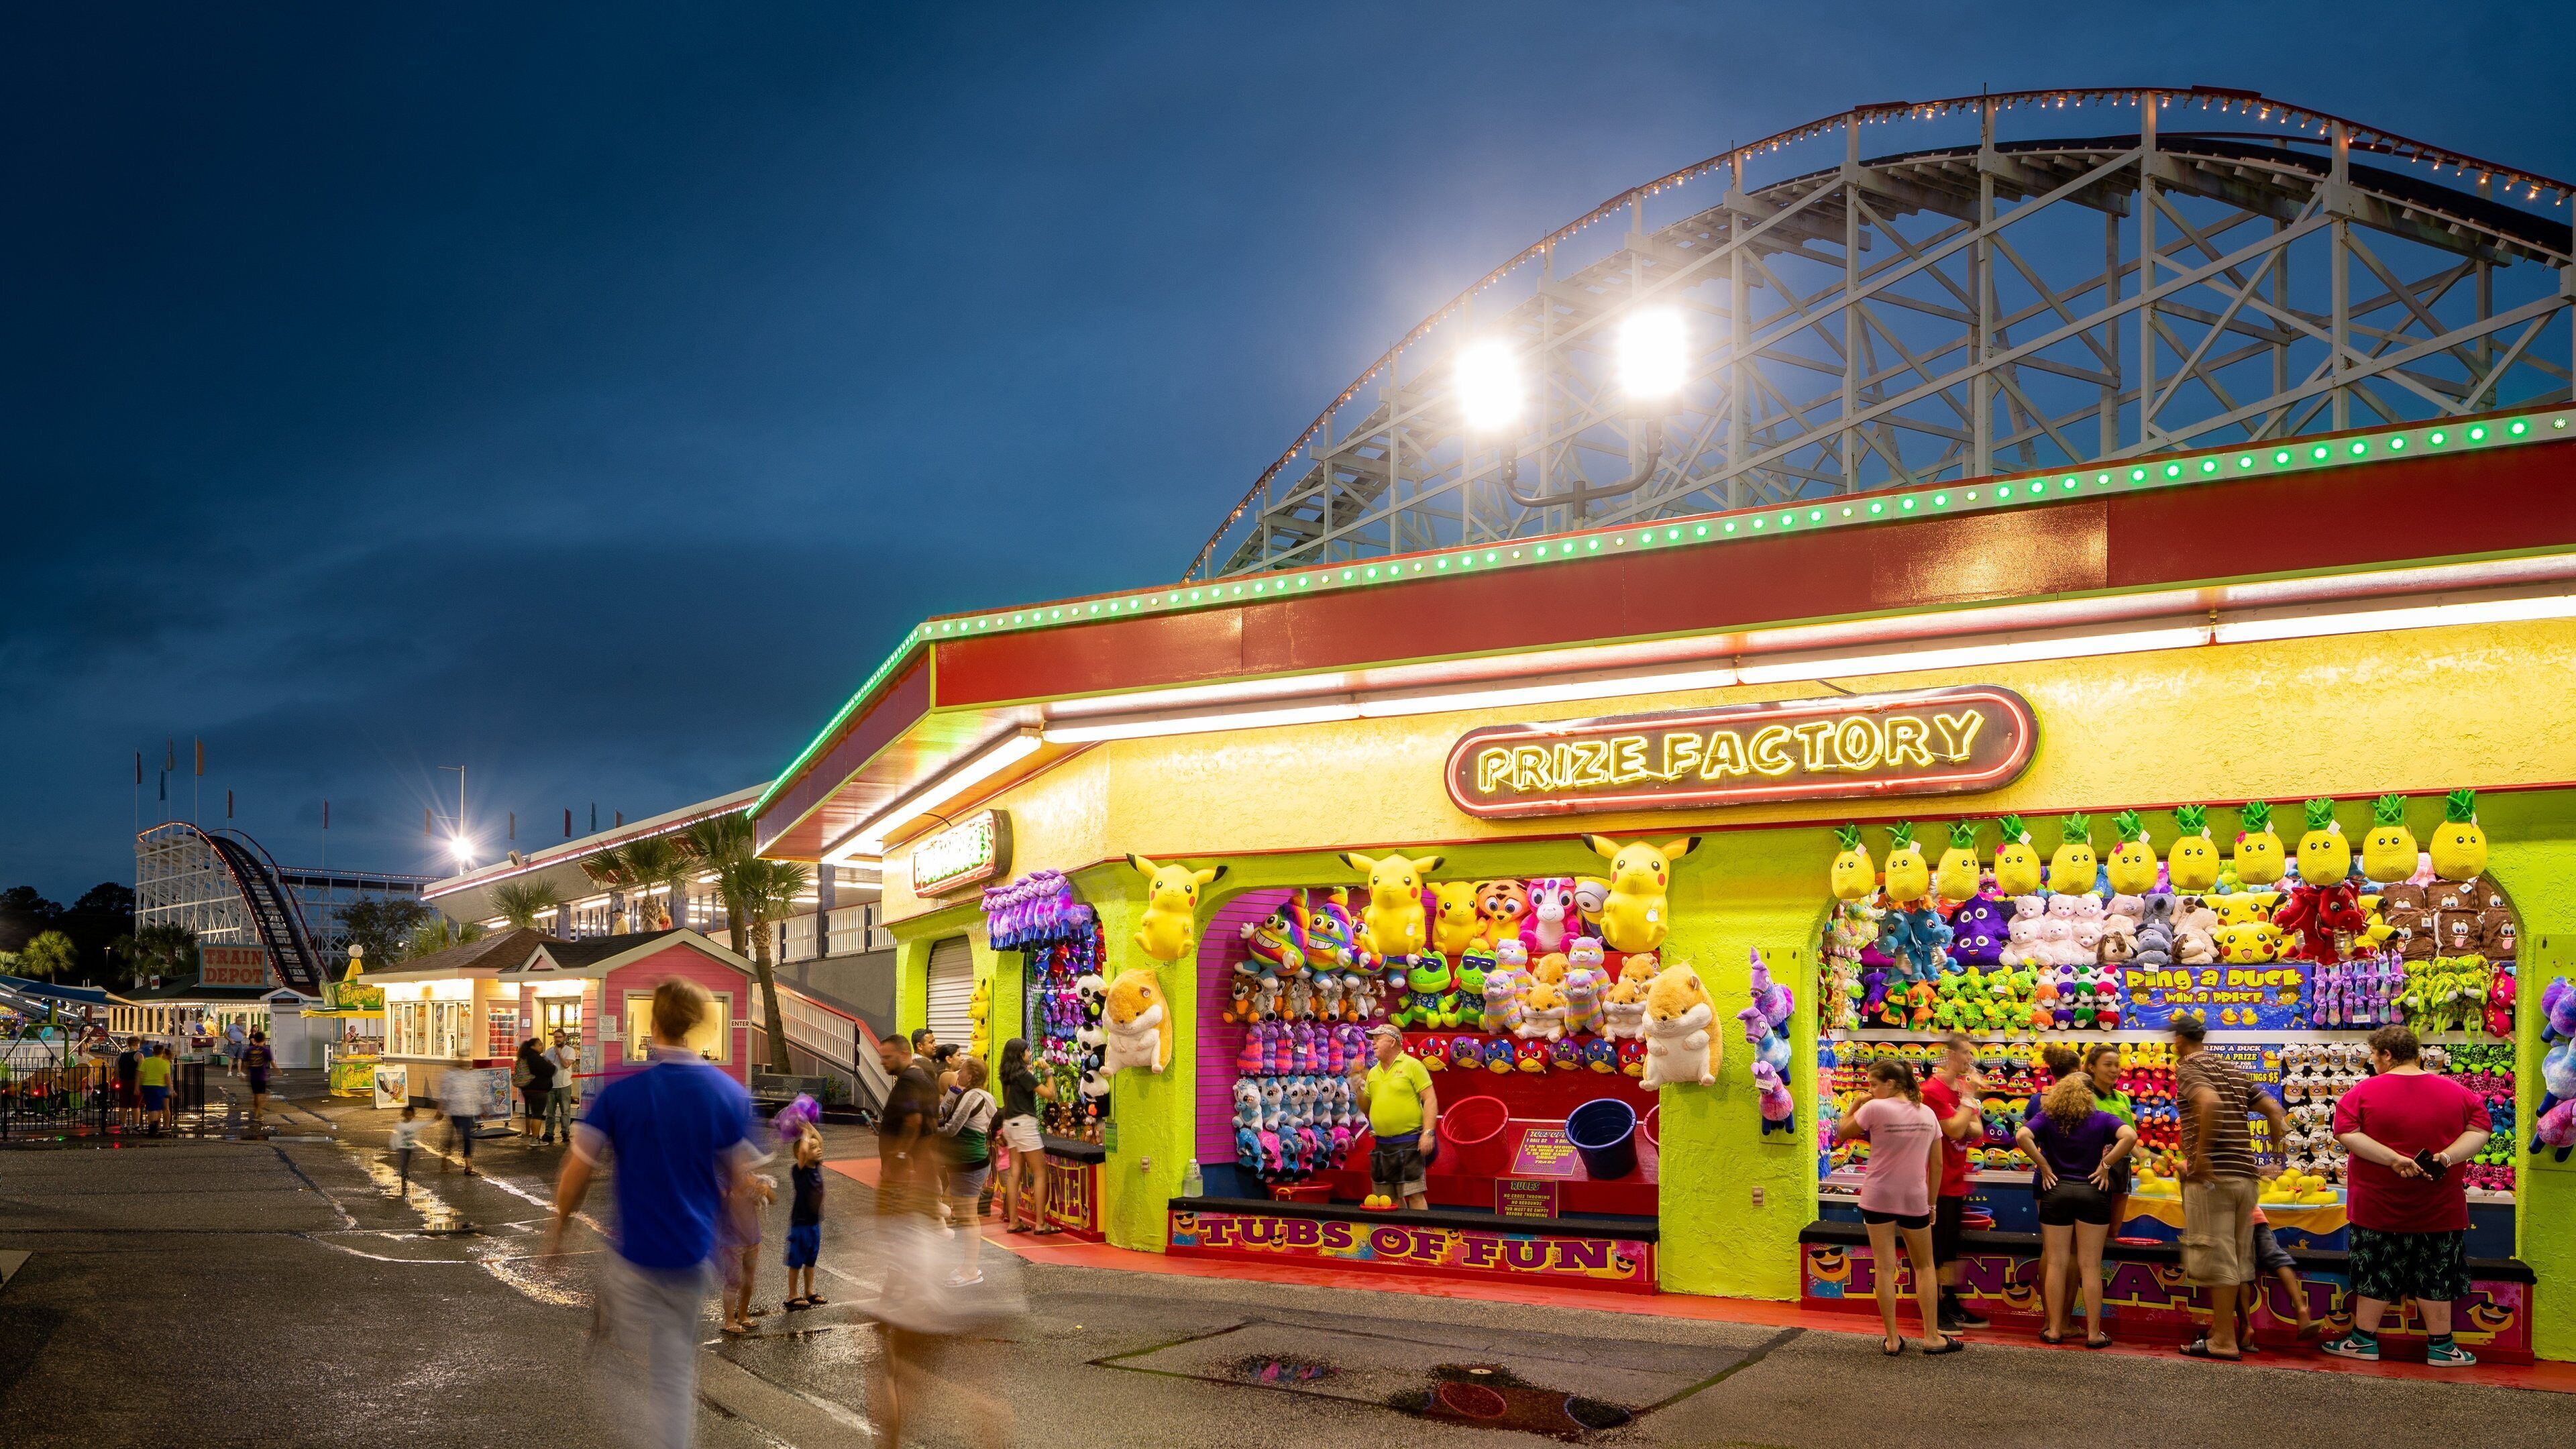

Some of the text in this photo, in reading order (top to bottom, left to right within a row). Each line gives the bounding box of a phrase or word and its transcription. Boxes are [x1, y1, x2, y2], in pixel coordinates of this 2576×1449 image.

[1478, 708, 1984, 793] PRIZE FACTORY
[205, 949, 263, 965] TRAIN
[204, 967, 263, 983] DEPOT
[2246, 1071, 2279, 1083] RINGS $5
[2250, 1138, 2263, 1153] OU
[1511, 1181, 1540, 1191] RULES
[1198, 1218, 1616, 1271] TUBS OF FUN
